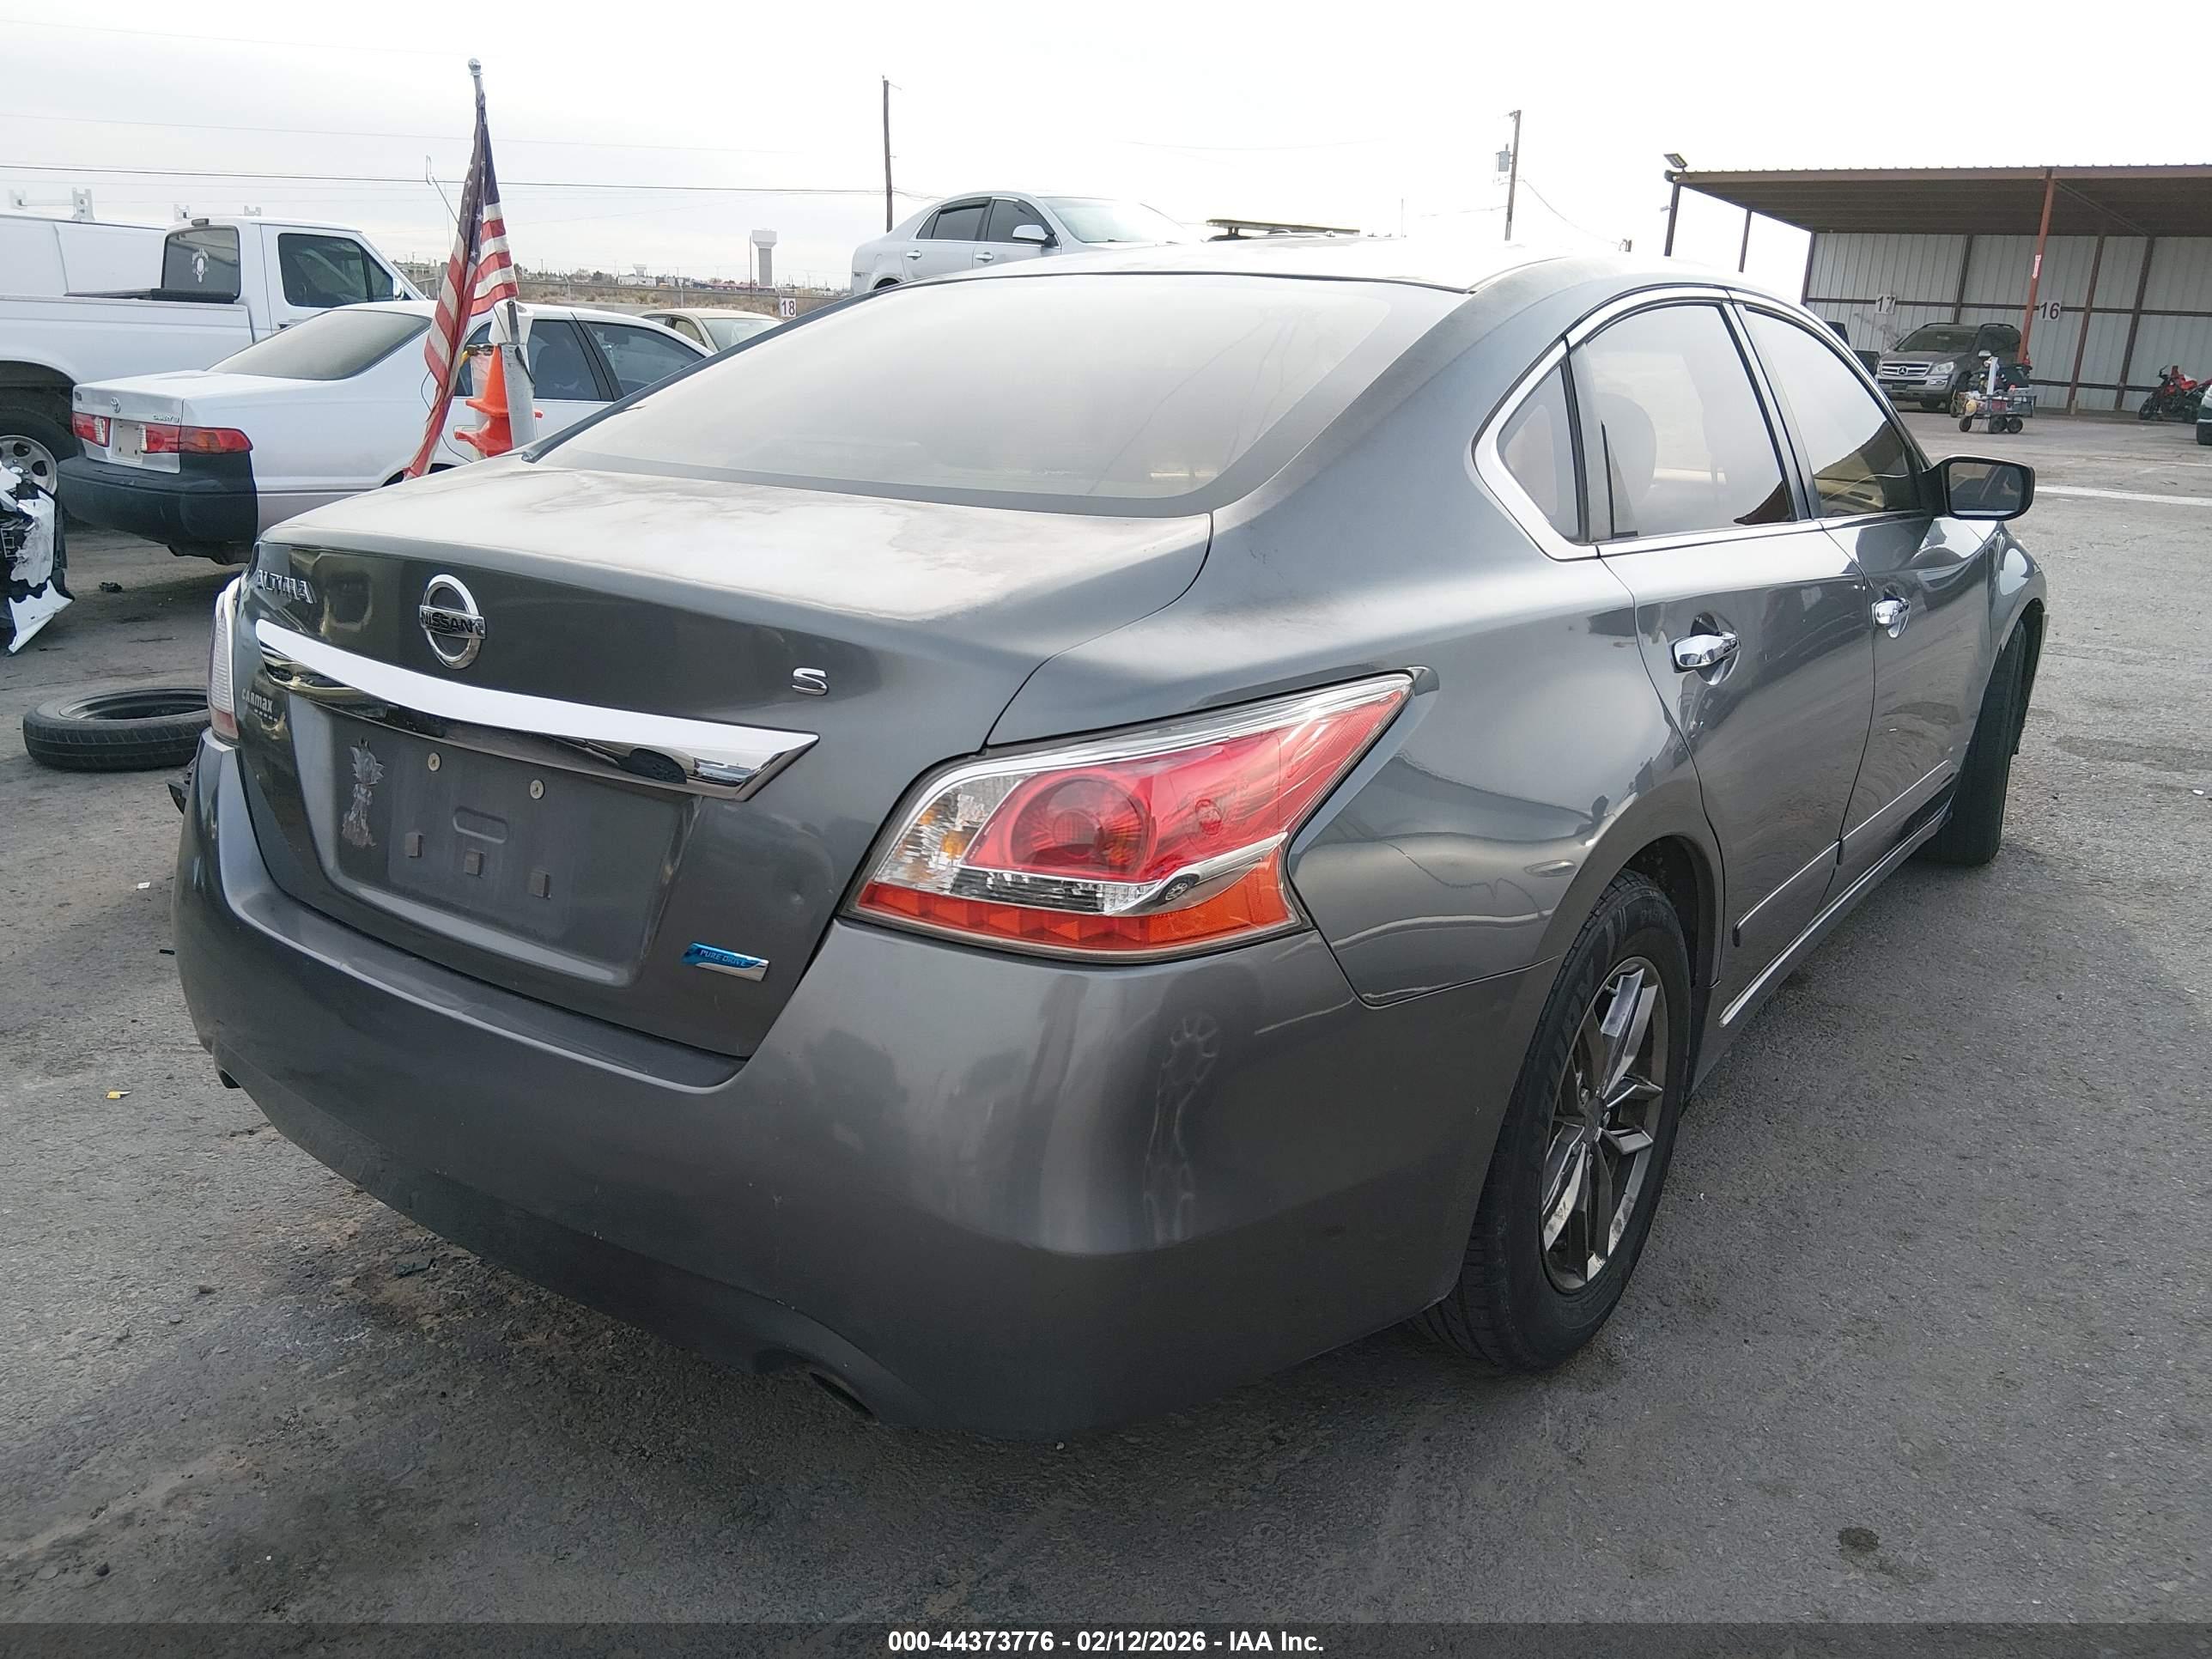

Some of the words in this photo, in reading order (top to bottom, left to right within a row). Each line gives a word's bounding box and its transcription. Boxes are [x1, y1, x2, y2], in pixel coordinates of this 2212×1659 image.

[781, 299, 796, 316] 18
[1875, 295, 1896, 313] 17
[2039, 301, 2060, 319] 16
[421, 611, 473, 634] NISSAN
[792, 667, 827, 696] S
[700, 950, 722, 960] PURE
[722, 955, 746, 967] DRIVE
